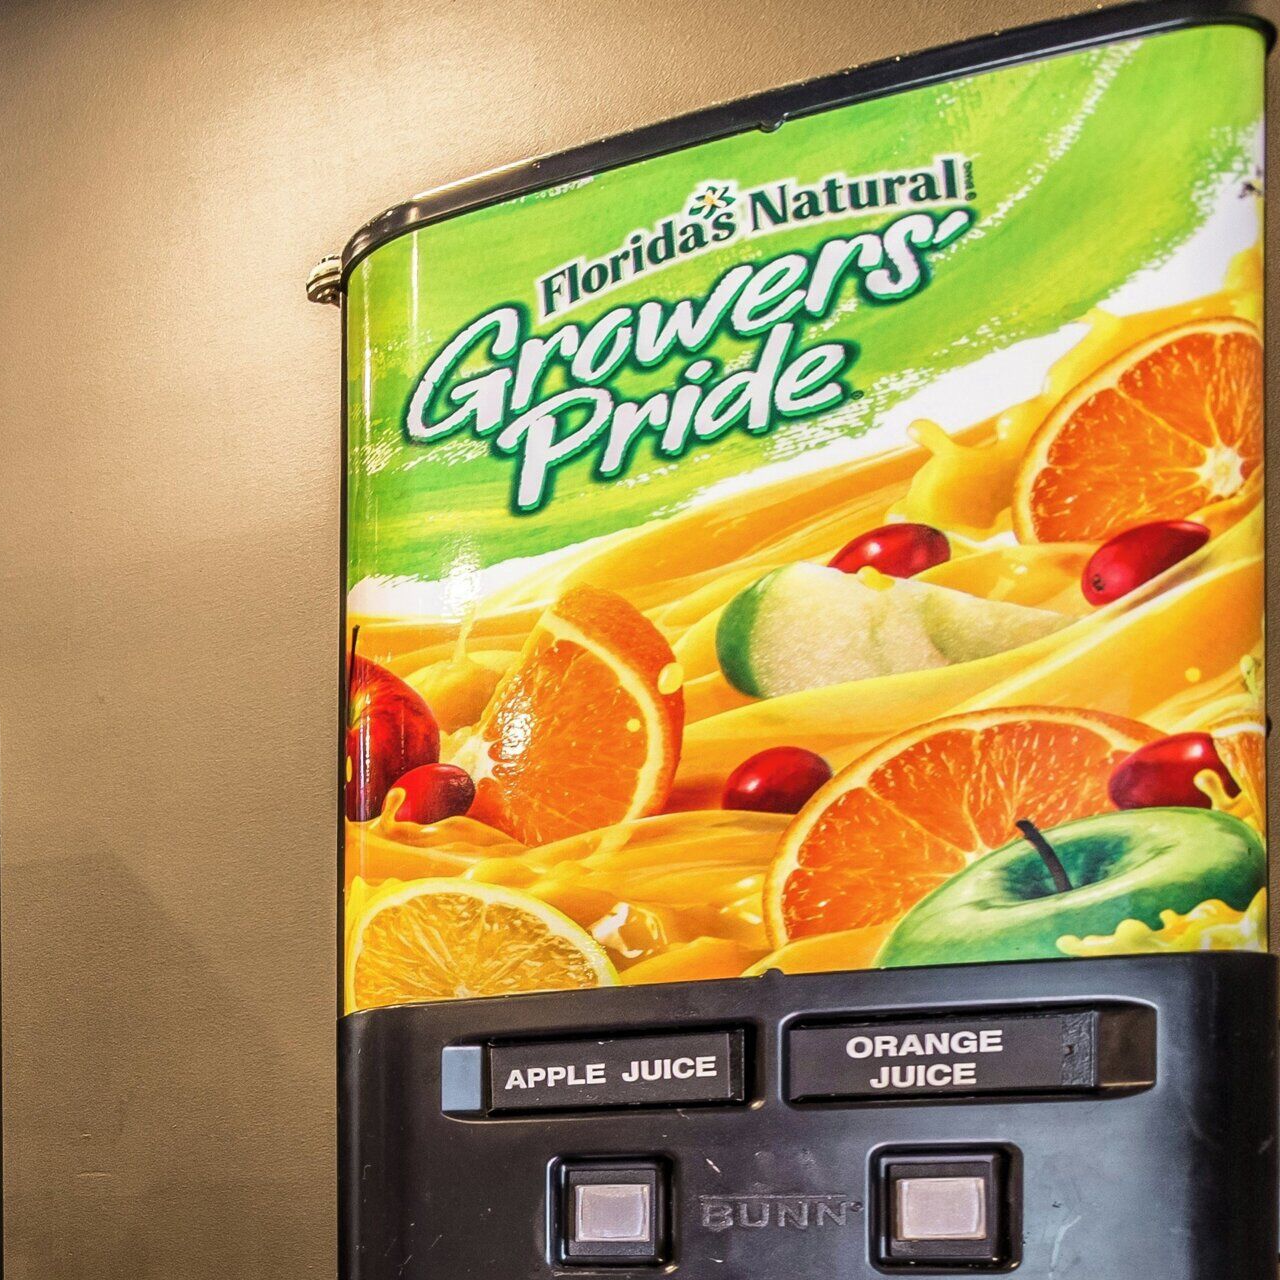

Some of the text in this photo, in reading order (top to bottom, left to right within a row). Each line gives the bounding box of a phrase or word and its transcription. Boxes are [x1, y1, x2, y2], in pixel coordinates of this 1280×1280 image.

[750, 158, 961, 232] Natural
[498, 324, 845, 507] Pride
[846, 1029, 1004, 1059] ORANGE
[504, 1056, 718, 1090] APPLE JUICE
[869, 1062, 977, 1089] JUICE
[702, 1201, 847, 1229] BUNN
